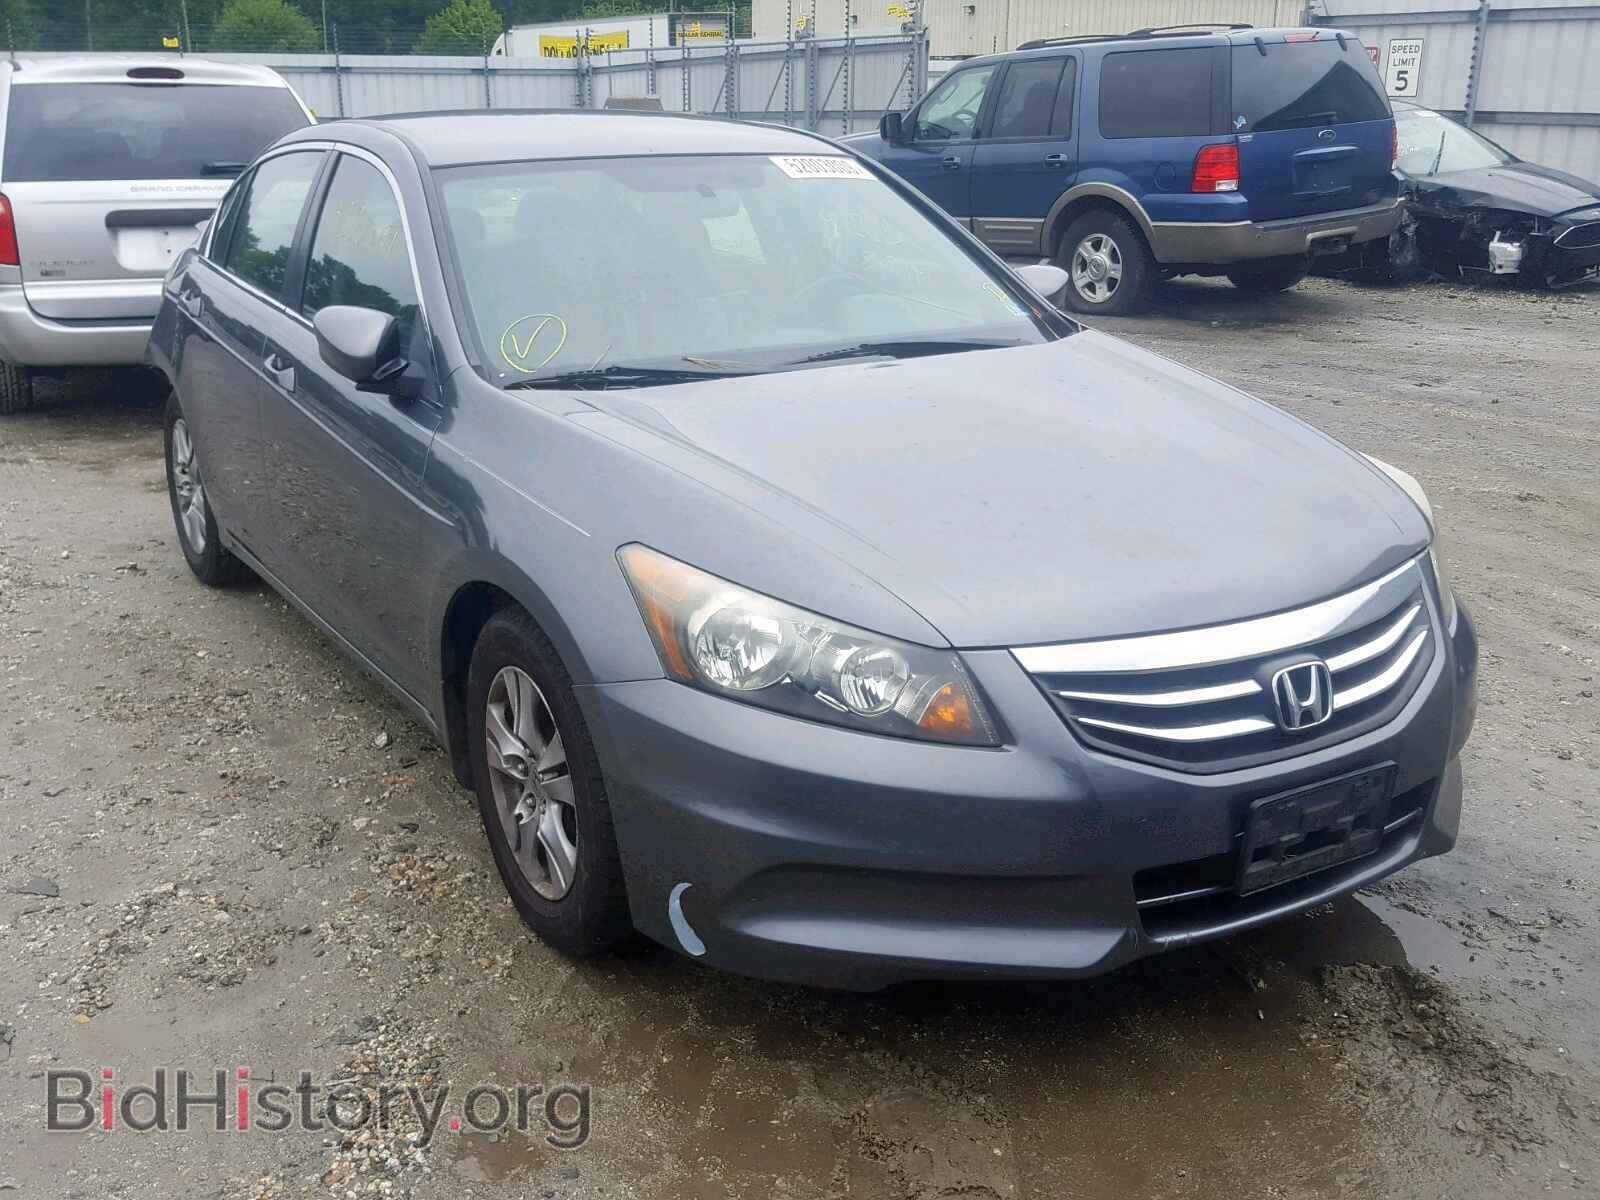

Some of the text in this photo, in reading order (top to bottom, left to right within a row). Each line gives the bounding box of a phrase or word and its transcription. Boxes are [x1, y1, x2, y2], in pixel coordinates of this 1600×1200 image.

[1391, 44, 1420, 54] SPEED
[1392, 57, 1416, 67] LIMIT
[1394, 70, 1409, 92] 5
